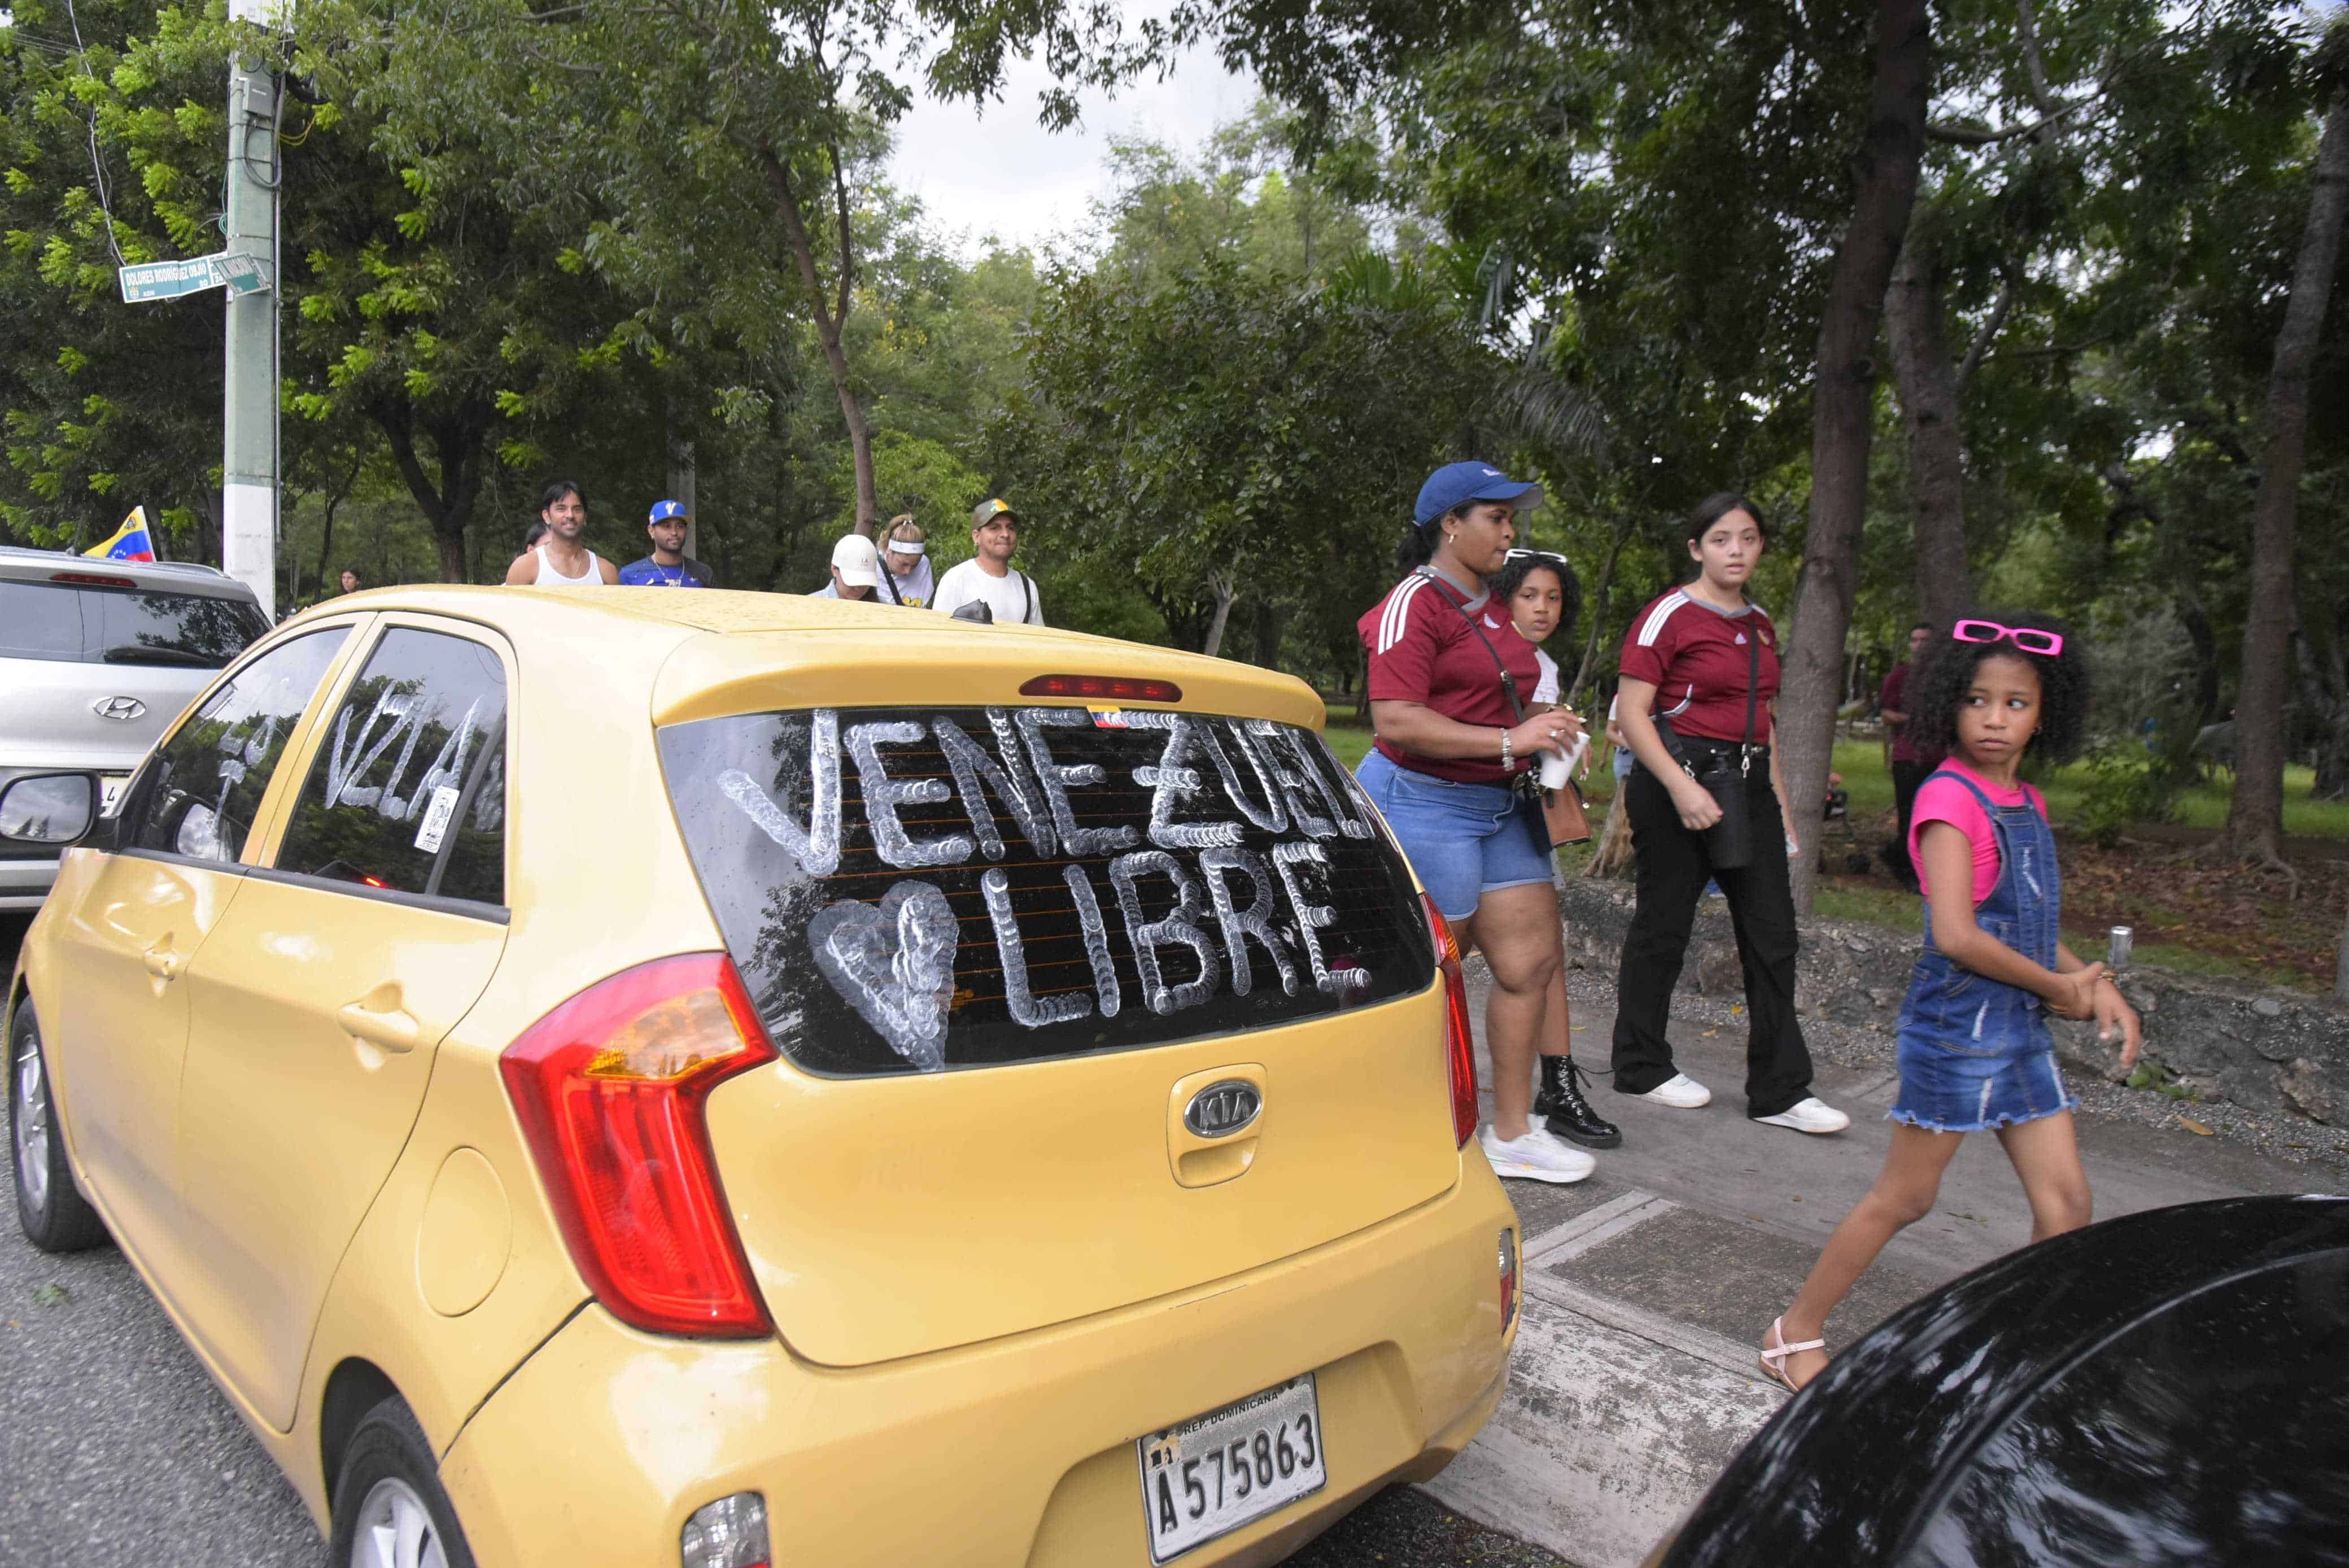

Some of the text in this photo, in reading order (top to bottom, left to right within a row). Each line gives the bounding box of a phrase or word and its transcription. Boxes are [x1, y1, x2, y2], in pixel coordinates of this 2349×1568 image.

[126, 270, 155, 286] DOLORES
[981, 842, 1373, 1029] LIBRE
[1198, 1092, 1250, 1128] KIA
[1184, 1392, 1278, 1435] REP. DOMINICANA
[1158, 1413, 1316, 1535] A575863
